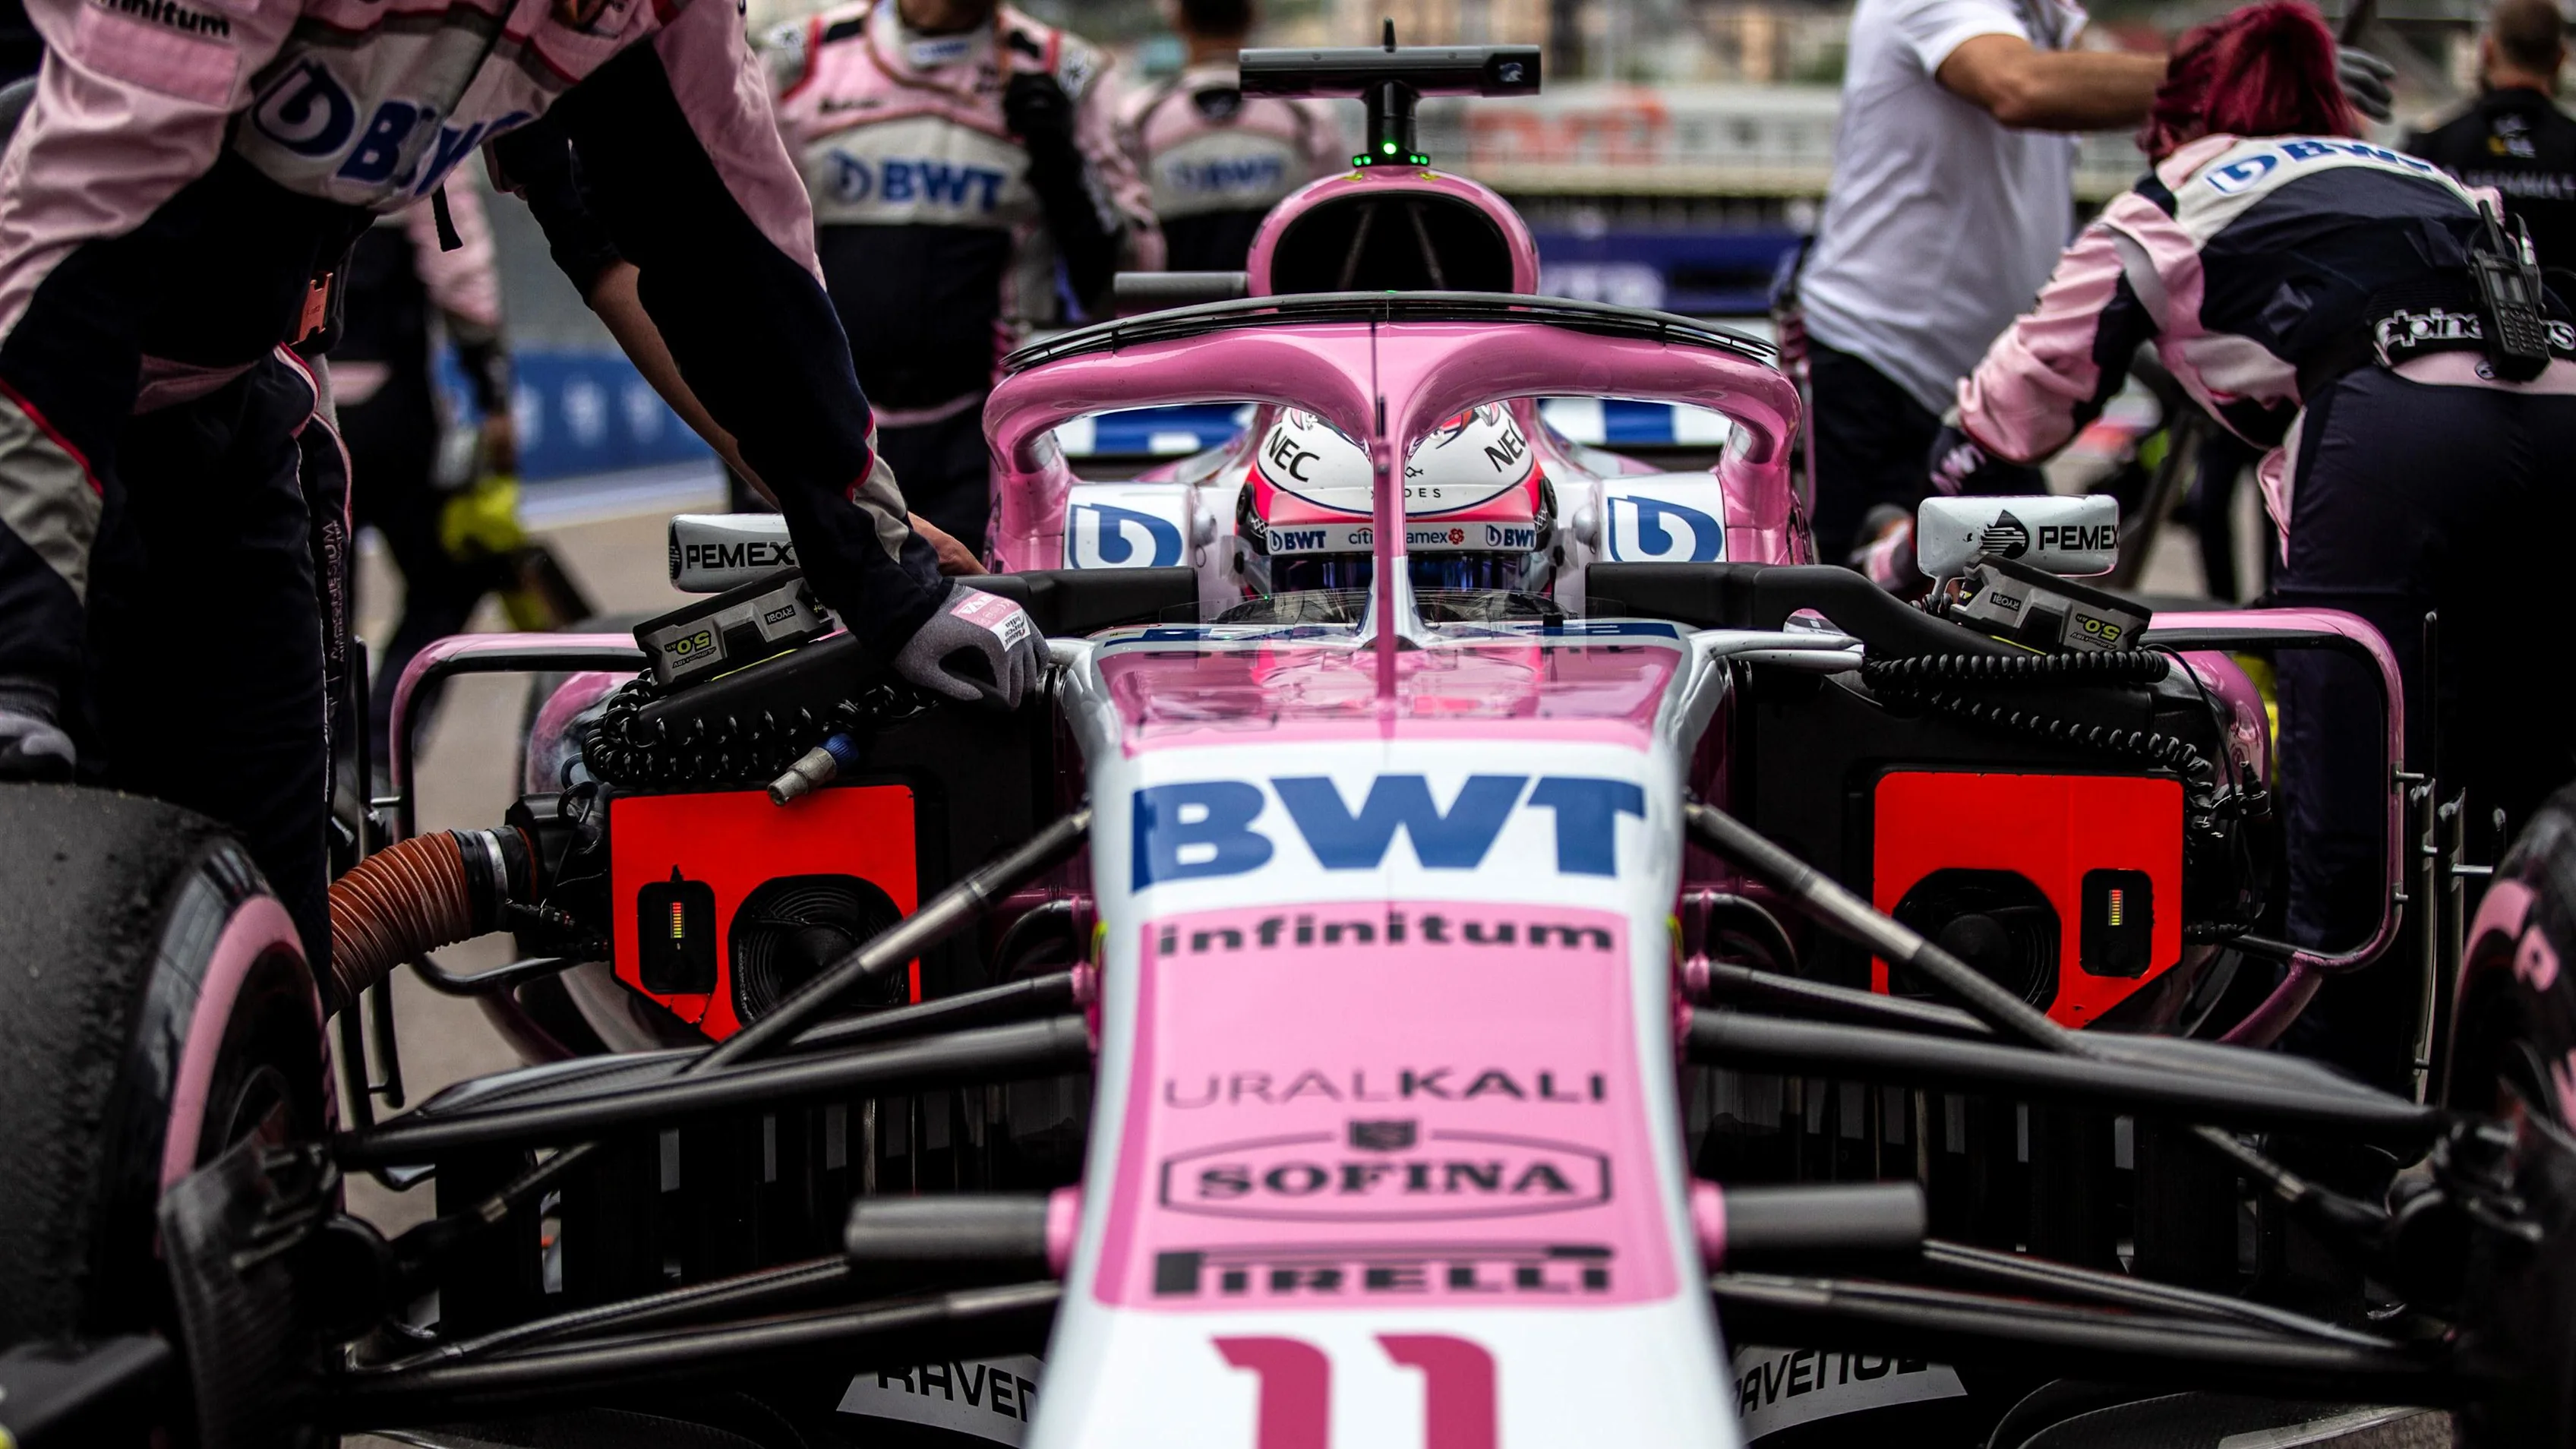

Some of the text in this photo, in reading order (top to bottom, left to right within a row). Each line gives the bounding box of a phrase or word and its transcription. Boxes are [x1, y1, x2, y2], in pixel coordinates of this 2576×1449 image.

[882, 160, 1007, 213] BWT
[1265, 426, 1321, 483] NEC
[687, 541, 795, 570] PEMEX
[1284, 531, 1326, 550] BWT
[1504, 529, 1536, 548] BWT
[2038, 525, 2119, 551] PEMEX
[766, 605, 795, 624] RYOBI
[1992, 593, 2020, 611] RYOBI
[1132, 773, 1646, 894] BWT
[1156, 911, 1615, 957] infinitum
[1163, 1067, 1606, 1109] URALKALI
[1197, 1160, 1578, 1200] SOFINA
[1153, 1241, 1616, 1296] PIRELLI
[1209, 1332, 1502, 1449] 11
